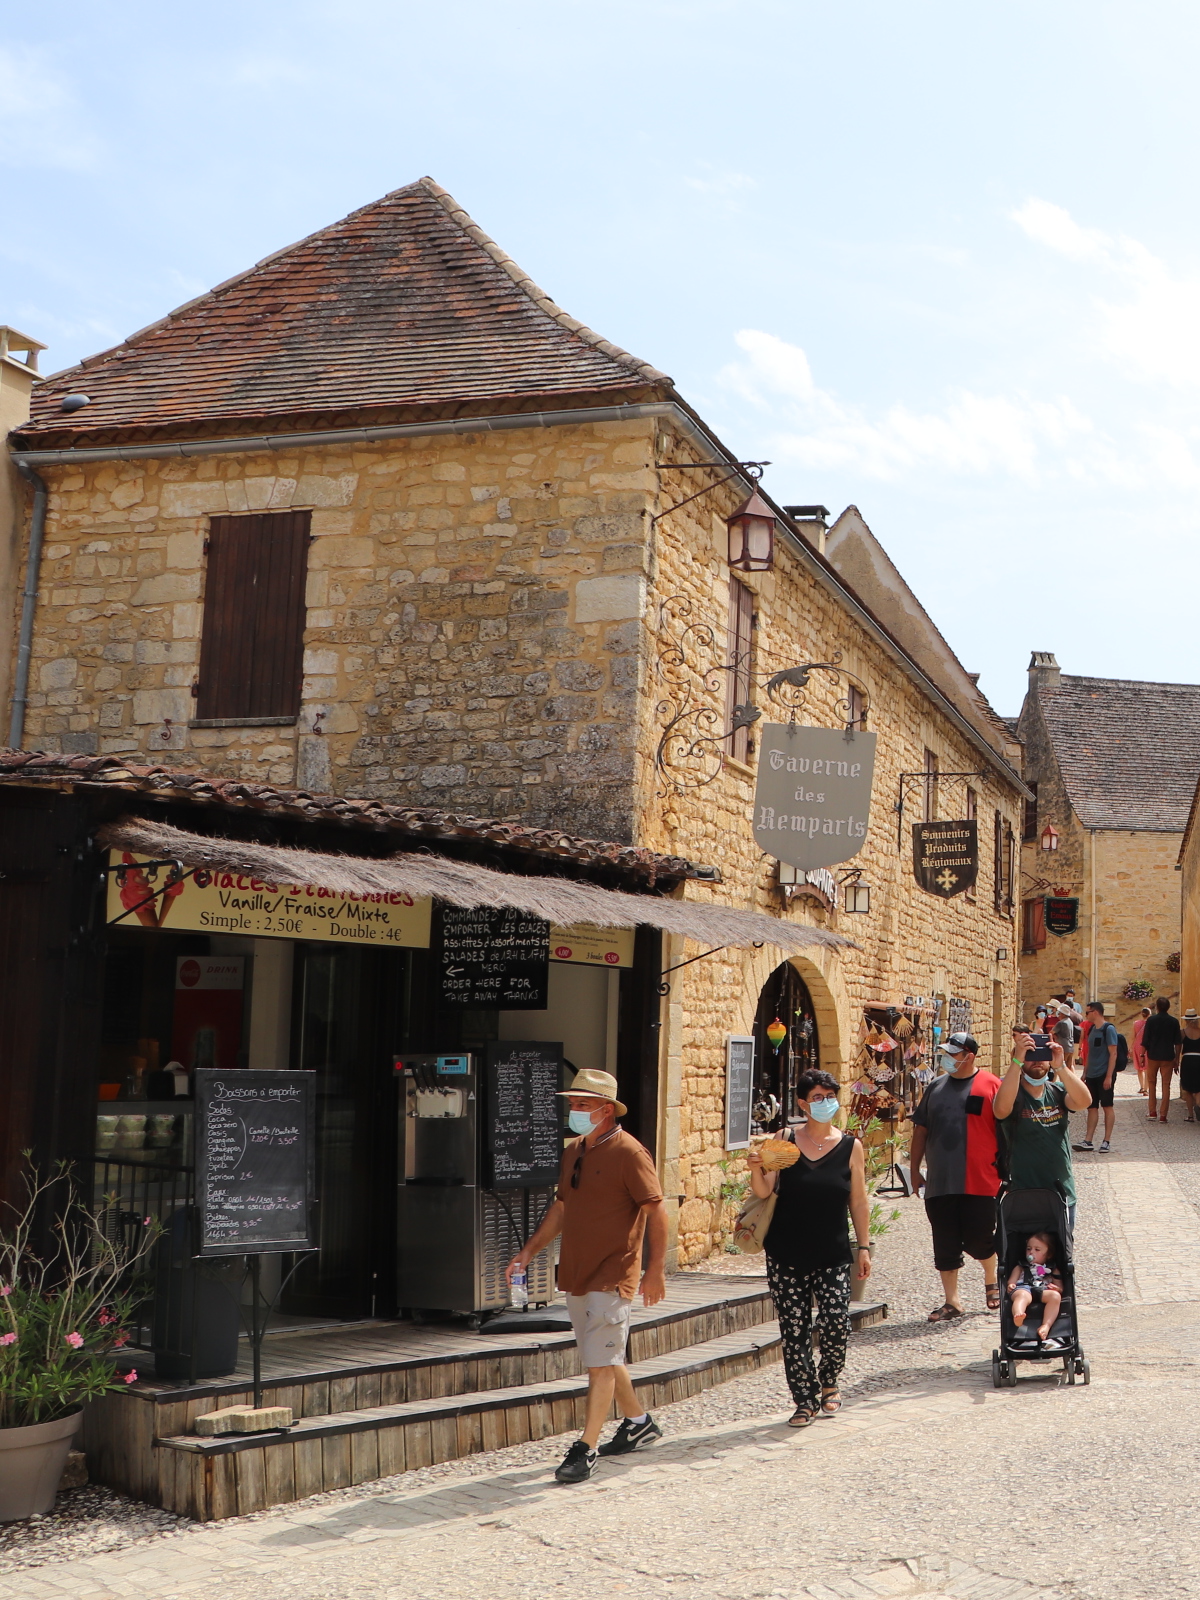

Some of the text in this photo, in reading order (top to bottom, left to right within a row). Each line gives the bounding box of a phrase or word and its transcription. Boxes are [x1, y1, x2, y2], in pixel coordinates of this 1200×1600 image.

[768, 749, 861, 778] Taverne
[794, 786, 825, 803] des
[757, 805, 866, 839] Remparts
[921, 829, 970, 840] Souvenirs
[925, 842, 967, 856] Produits
[921, 857, 972, 869] Régionaux
[219, 891, 390, 924] Vanille/Fraise/Mixte
[443, 909, 498, 922] COMMANDEZ
[505, 909, 517, 919] ICI
[200, 911, 251, 931] Simple
[263, 917, 303, 934] 2,50€
[330, 923, 377, 939] Double
[444, 923, 492, 936] EMPORTER
[501, 922, 516, 933] LES
[541, 938, 550, 946] et
[442, 951, 485, 963] SALADES
[490, 951, 500, 961] de
[501, 950, 518, 961] 12H
[528, 950, 545, 961] 17H
[207, 966, 239, 974] DRINK
[443, 977, 531, 988] ORDER HERE FOR
[445, 990, 538, 1002] TAKE AWAY THANKS
[213, 1081, 301, 1101] Boissons à emporter
[207, 1137, 235, 1147] Orangina
[240, 1171, 254, 1180] 2€
